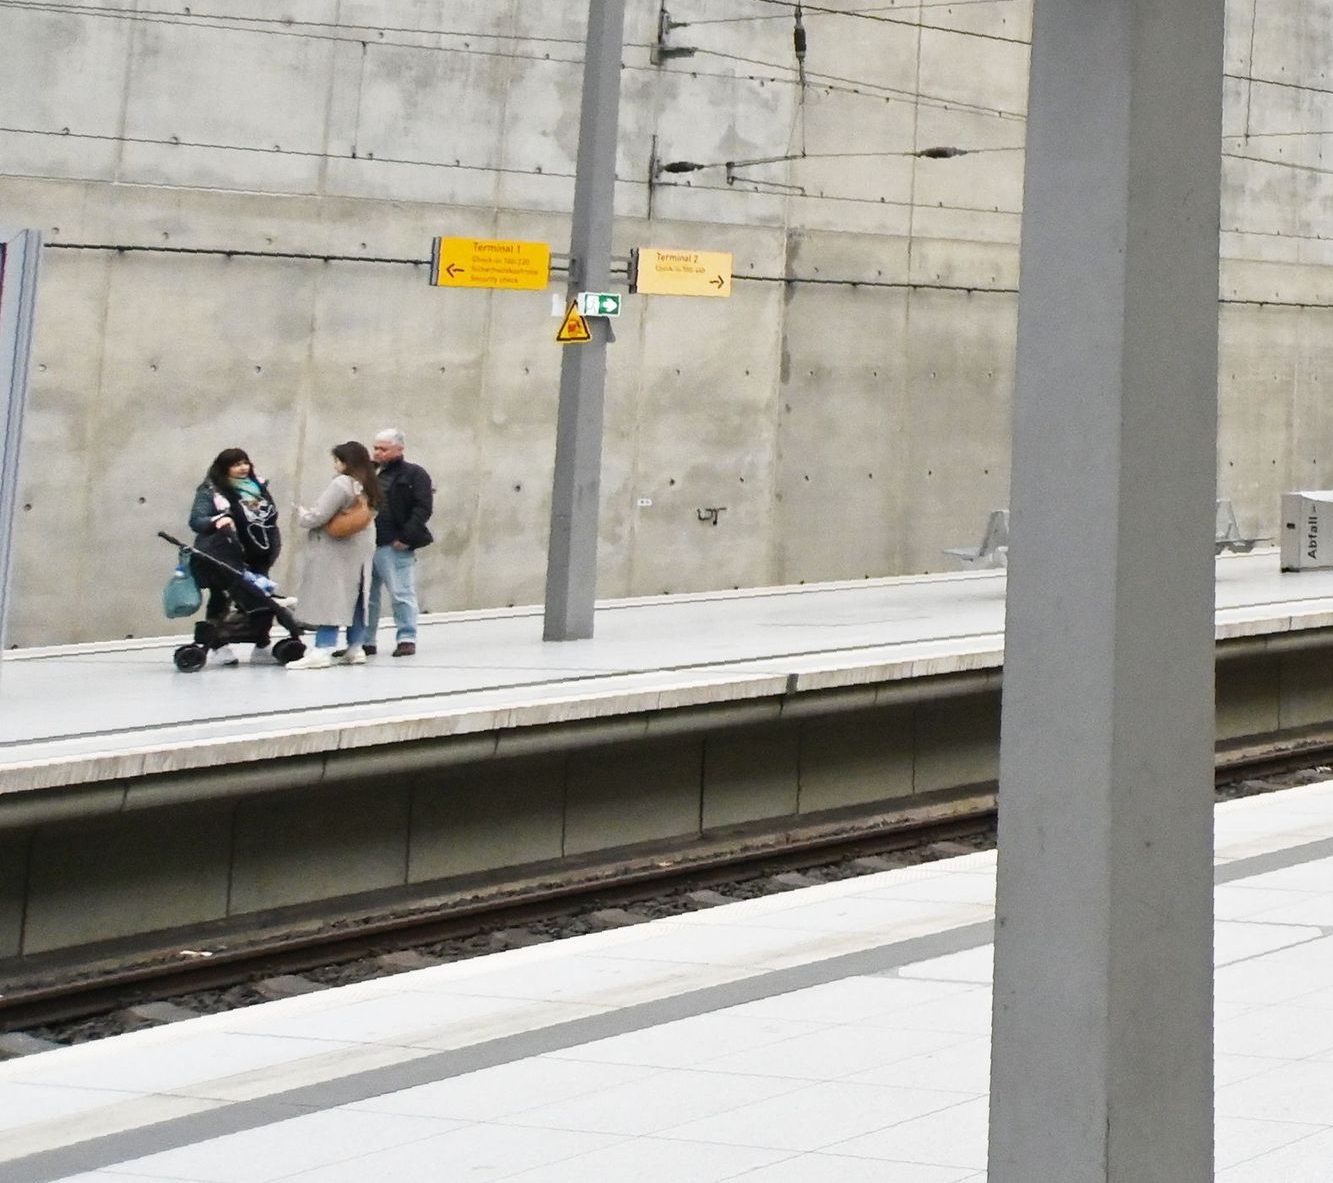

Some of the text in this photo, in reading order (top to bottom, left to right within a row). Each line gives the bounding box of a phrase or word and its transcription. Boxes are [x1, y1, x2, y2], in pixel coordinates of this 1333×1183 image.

[473, 241, 514, 254] Terminal
[656, 252, 692, 263] Terminal
[1307, 516, 1318, 560] Abfall
